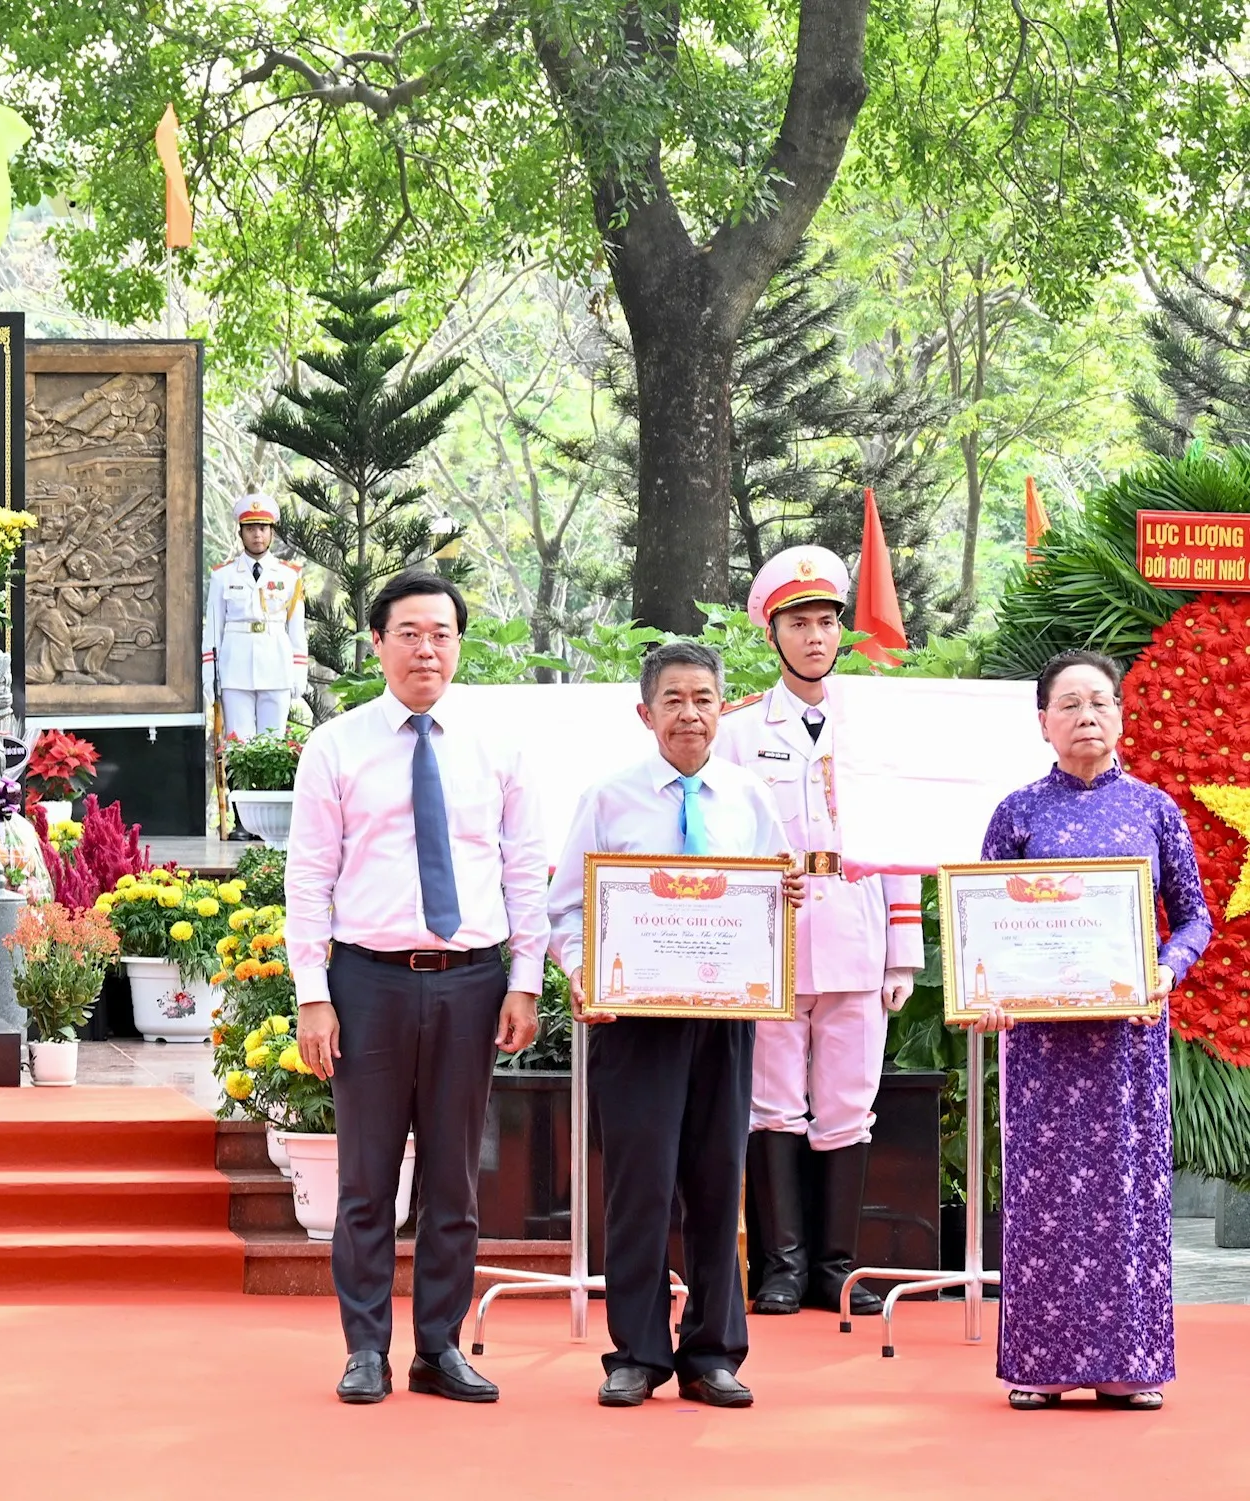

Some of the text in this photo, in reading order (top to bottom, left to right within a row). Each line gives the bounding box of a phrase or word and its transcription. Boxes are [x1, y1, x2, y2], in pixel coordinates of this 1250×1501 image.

[1145, 523, 1179, 549] LỰC
[1184, 524, 1244, 551] LƯỢNG
[1144, 552, 1166, 578] ĐỜI
[1169, 553, 1191, 579] ĐỜI
[1194, 558, 1215, 580] GHI
[1218, 555, 1246, 581] NHỚ
[651, 913, 684, 927] QUỐC
[686, 917, 707, 926] GHI
[710, 915, 742, 928] CÔNG
[1011, 916, 1044, 930] QUỐC
[1046, 919, 1067, 929] GHI
[1070, 916, 1102, 928] CÔNG
